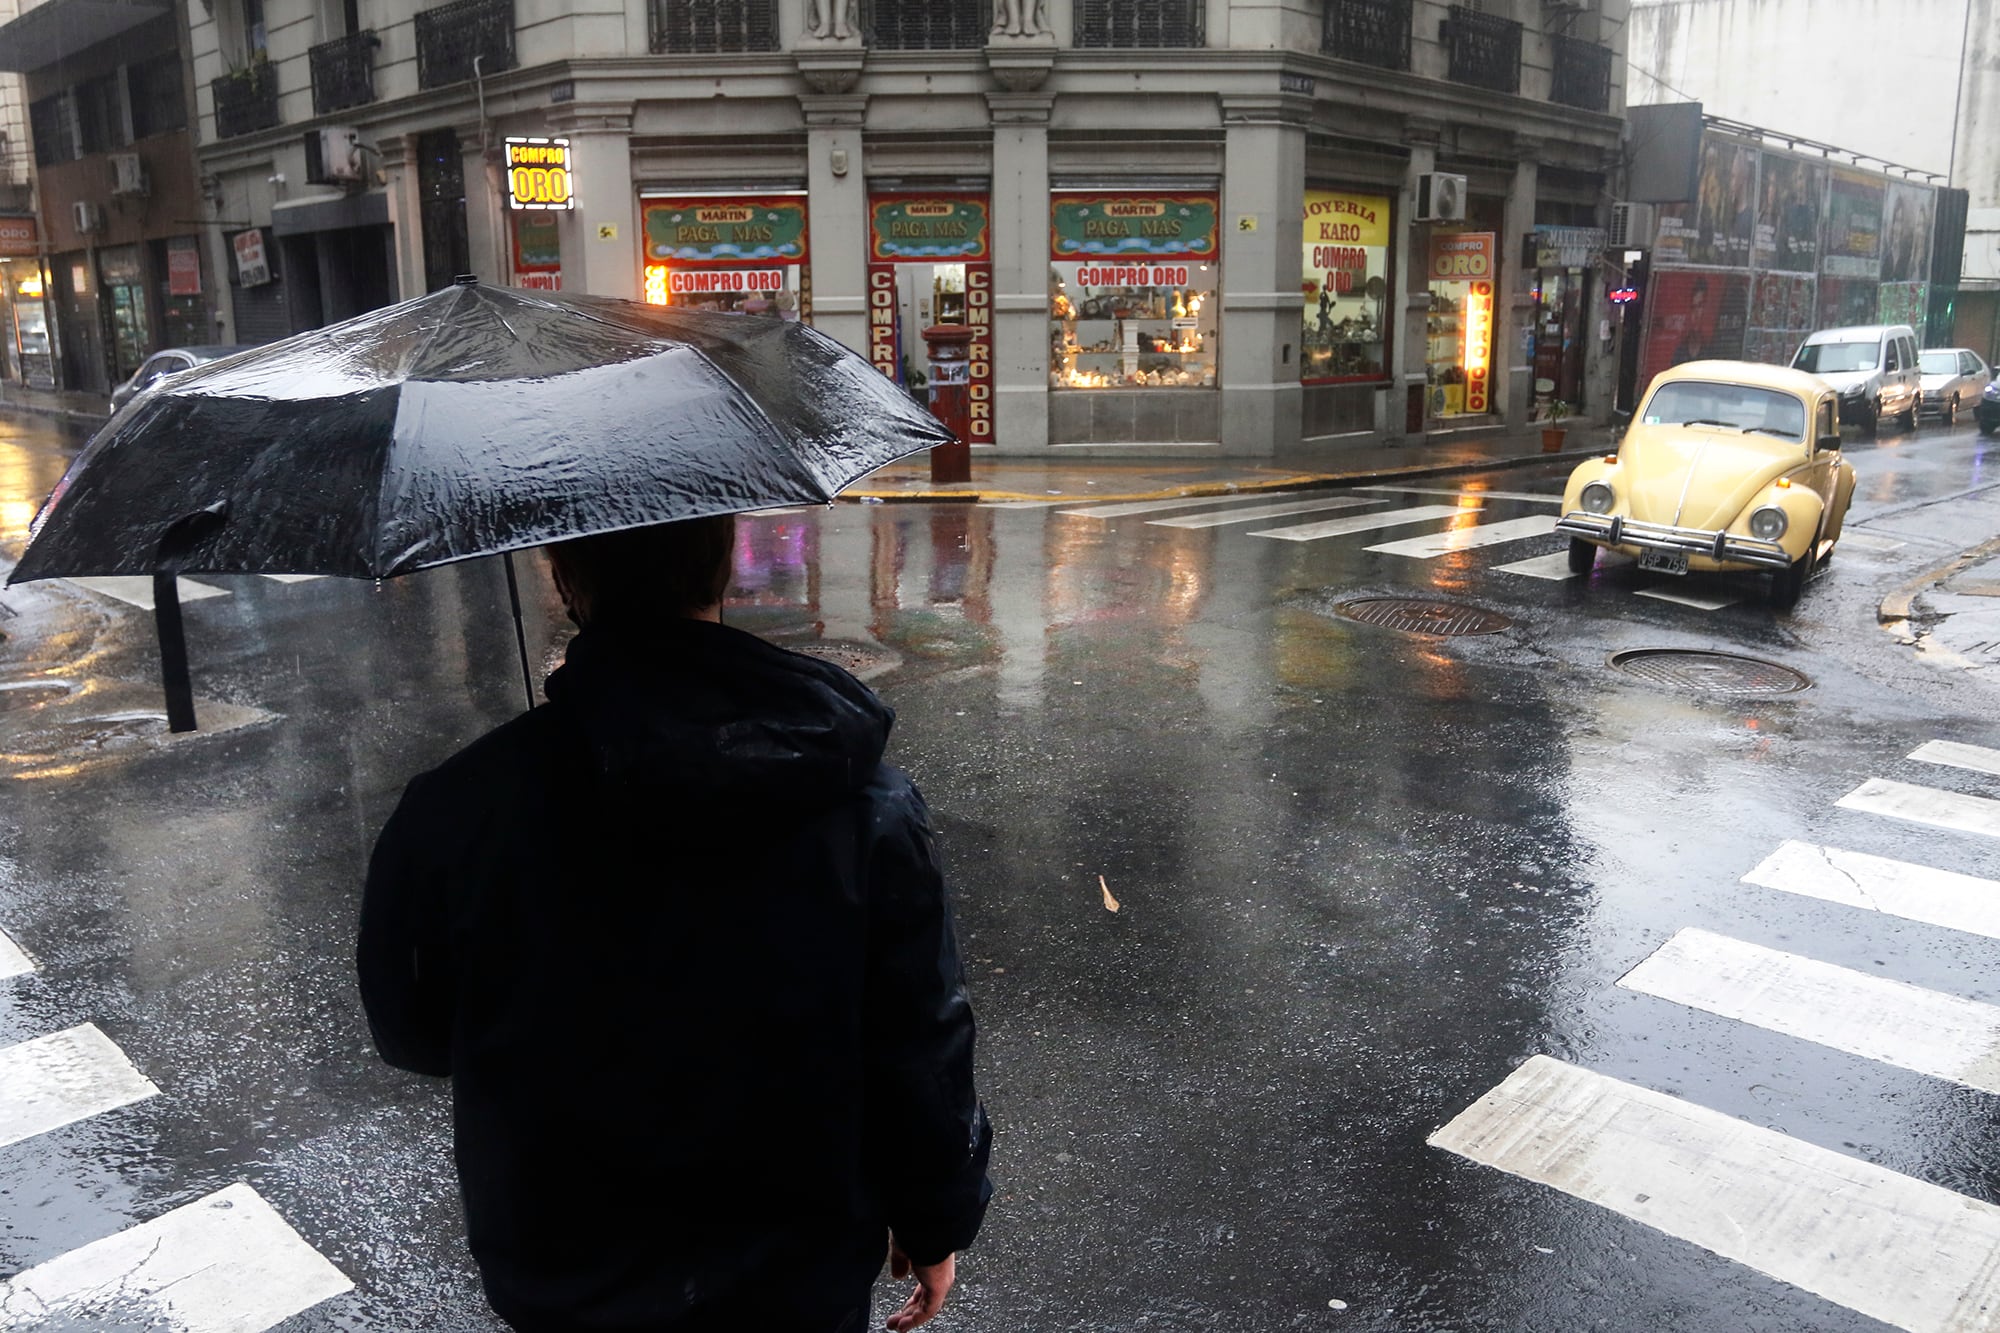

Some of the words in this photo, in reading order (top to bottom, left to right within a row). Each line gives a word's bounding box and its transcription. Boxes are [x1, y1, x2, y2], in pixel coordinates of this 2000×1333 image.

[511, 147, 565, 164] COMPRO
[512, 167, 569, 203] ORO
[701, 210, 747, 221] MARTIN
[910, 206, 948, 214] MARTIN
[1111, 205, 1156, 215] MARTIN
[1303, 200, 1376, 224] JOYERIA
[677, 225, 721, 243] PAGA
[732, 225, 773, 242] MAS
[891, 221, 930, 238] PAGA
[932, 221, 968, 238] MAS
[1085, 219, 1131, 238] PAGA
[1141, 219, 1183, 237] MAS
[1320, 222, 1360, 241] KARO
[1440, 241, 1483, 250] COMPRO
[1313, 246, 1366, 270] COMPRO
[1435, 254, 1487, 275] ORO
[671, 272, 743, 291] COMPRO
[747, 271, 781, 290] ORO
[1077, 267, 1149, 286] COMPRO
[1153, 267, 1187, 286] ORO
[1326, 270, 1351, 293] ORO
[968, 271, 990, 378] COMPRO
[1473, 281, 1491, 358] OMPRO
[1469, 367, 1486, 409] ORO
[969, 384, 990, 436] ORO
[1641, 553, 1661, 567] VSP
[1667, 558, 1687, 572] 759
